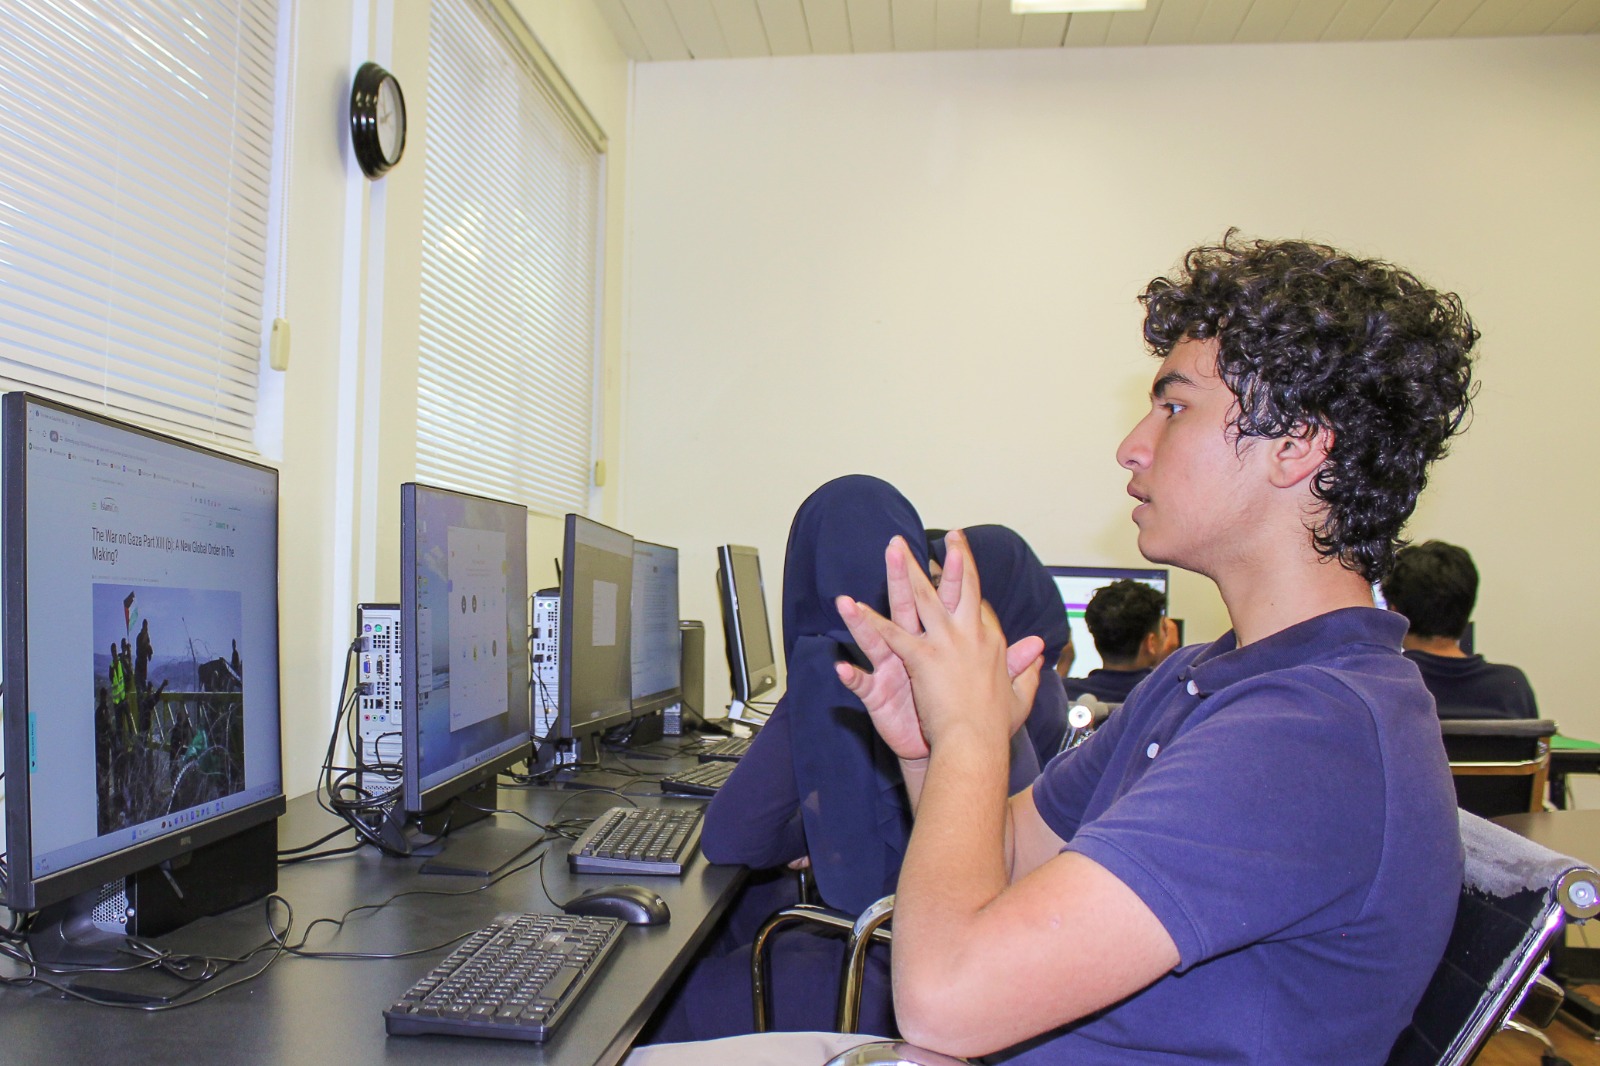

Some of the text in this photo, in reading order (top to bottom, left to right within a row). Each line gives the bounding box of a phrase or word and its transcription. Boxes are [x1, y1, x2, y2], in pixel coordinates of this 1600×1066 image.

[92, 526, 104, 542] The
[105, 529, 118, 543] War
[118, 533, 127, 545] on
[127, 532, 142, 547] Gaza
[143, 534, 155, 549] Part
[175, 538, 180, 551] A
[180, 539, 192, 553] New
[192, 541, 207, 554] Global
[208, 543, 220, 556] Order
[226, 545, 235, 558] The
[92, 546, 119, 566] Making?
